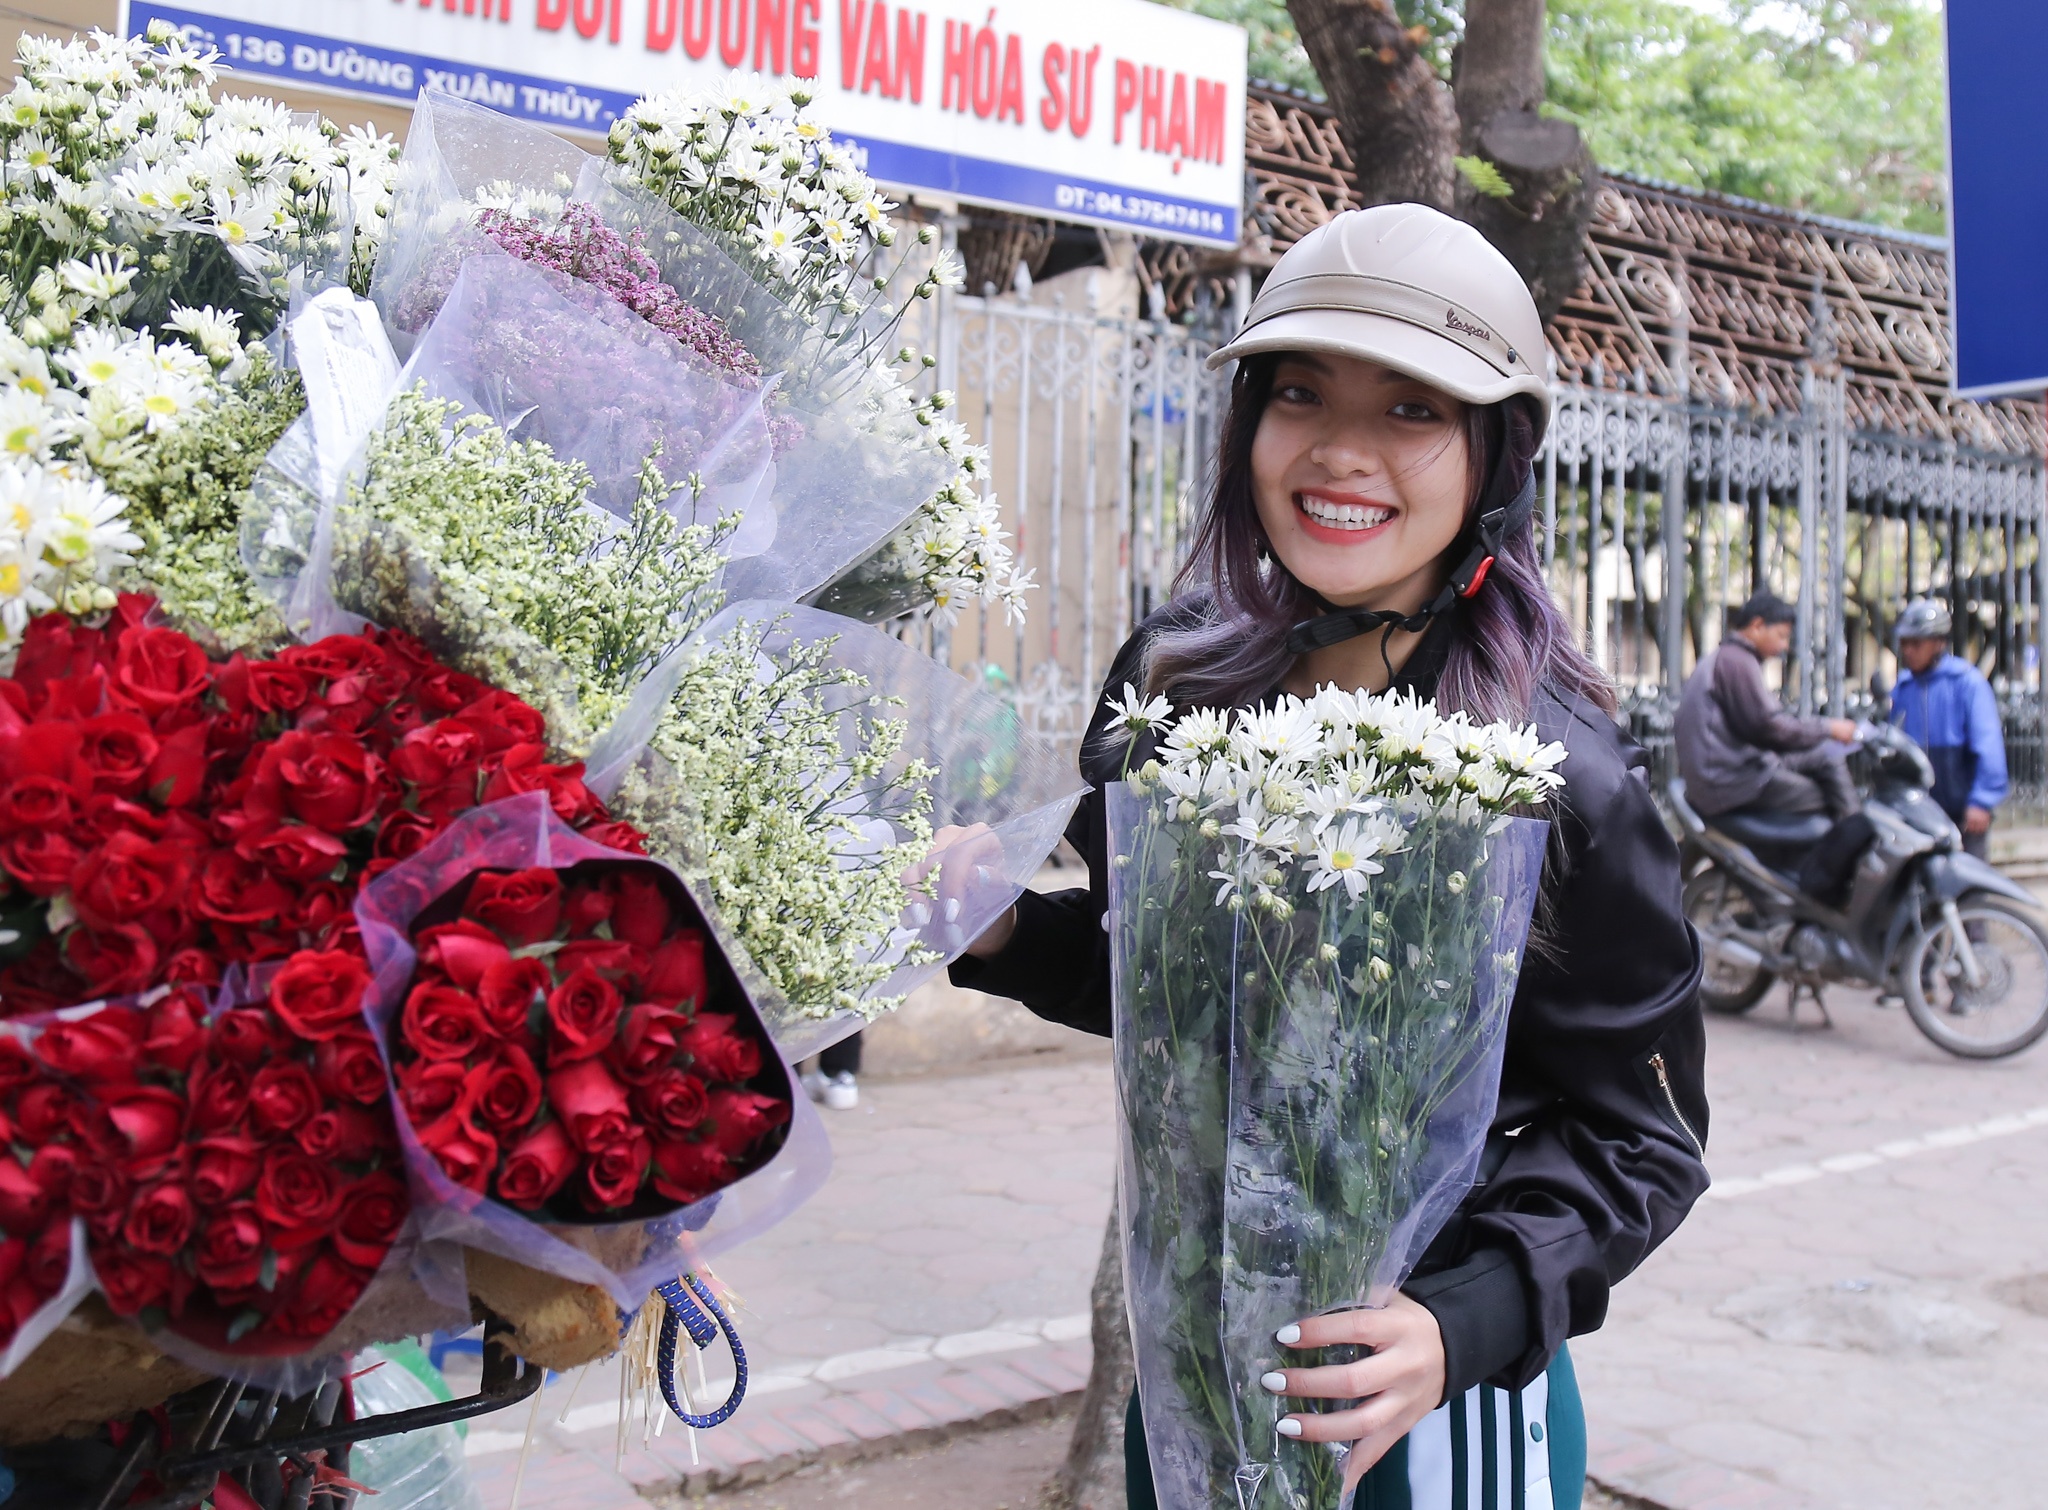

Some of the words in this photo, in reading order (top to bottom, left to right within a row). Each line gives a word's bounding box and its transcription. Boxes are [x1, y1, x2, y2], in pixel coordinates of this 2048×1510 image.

[224, 33, 286, 67] 136
[424, 67, 515, 108] XUÂN
[520, 85, 603, 123] THỦY
[941, 7, 1024, 125] HÓA
[1040, 40, 1101, 139] SƯ
[1114, 57, 1226, 175] PHẠM
